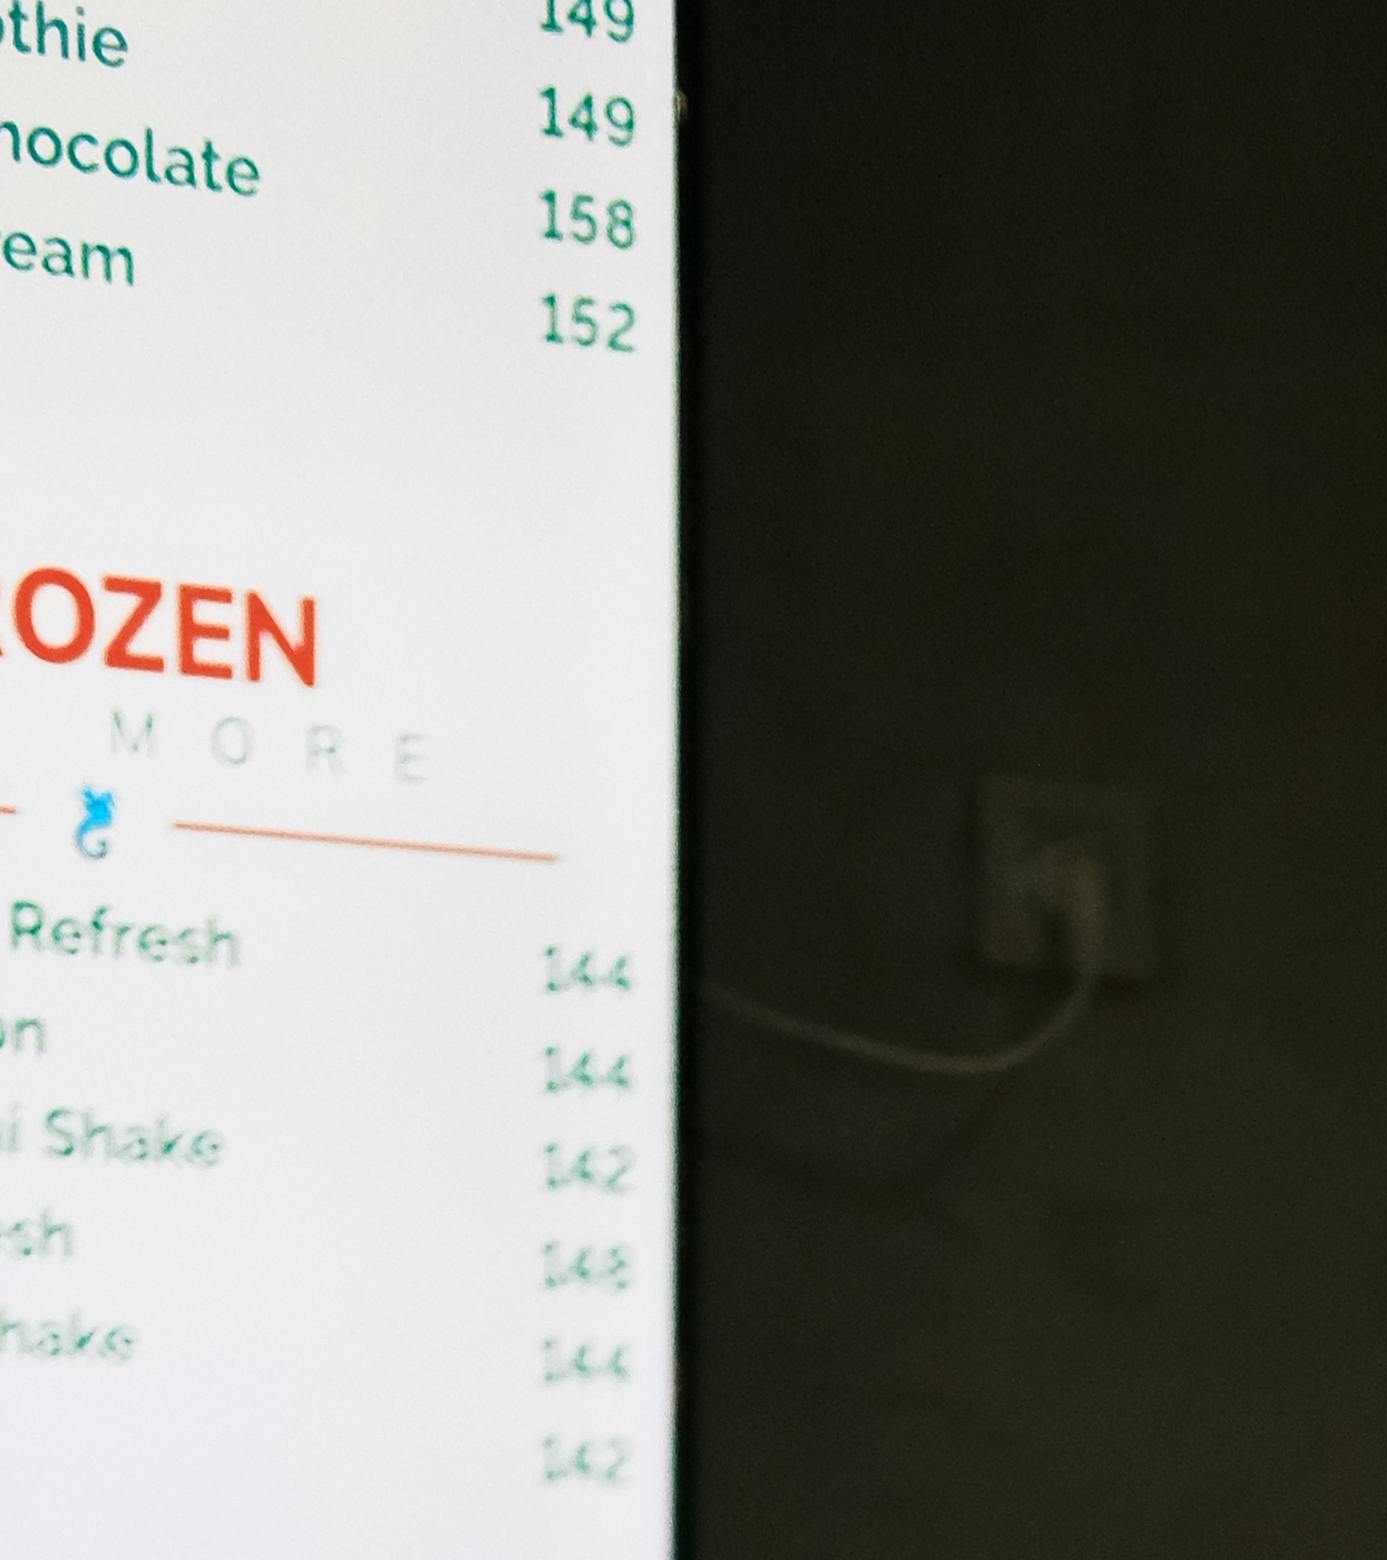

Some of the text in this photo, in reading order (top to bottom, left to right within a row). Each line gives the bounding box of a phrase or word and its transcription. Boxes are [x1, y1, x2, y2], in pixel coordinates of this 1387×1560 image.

[0, 0, 128, 67] thie
[540, 0, 635, 43] 149
[540, 86, 635, 147] 149
[540, 190, 635, 250] 158
[0, 231, 134, 286] eam
[541, 294, 636, 353] 152
[0, 567, 315, 687] OZEN
[12, 898, 241, 969] Refresh
[545, 943, 632, 991] 144
[0, 1016, 46, 1055] n
[545, 1045, 632, 1091] 144
[44, 1106, 226, 1168] Shake
[545, 1140, 638, 1192] 142
[0, 1207, 75, 1260] sh
[543, 1336, 631, 1383] 144
[543, 1431, 636, 1483] 142
